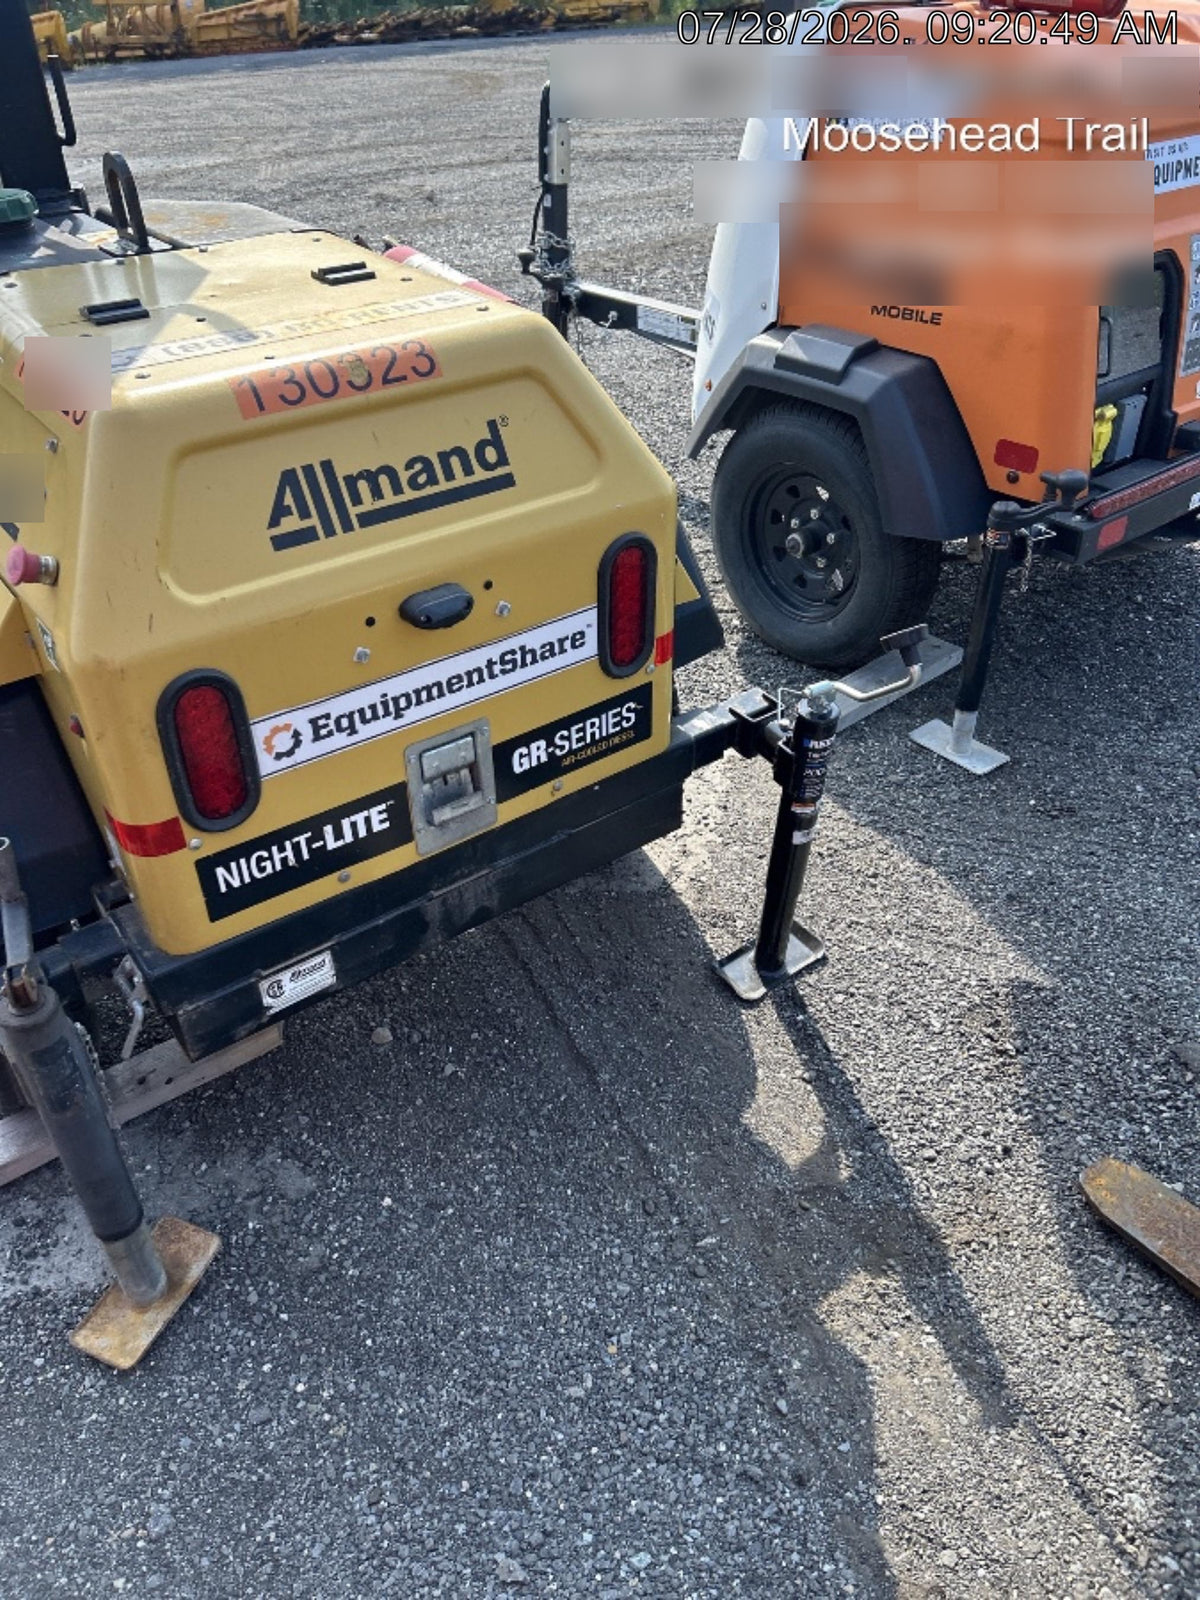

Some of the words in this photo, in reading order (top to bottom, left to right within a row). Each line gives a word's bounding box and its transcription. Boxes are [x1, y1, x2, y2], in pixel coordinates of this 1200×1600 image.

[870, 305, 943, 326] MOBILE
[236, 339, 438, 413] 130323
[267, 419, 510, 540] Allmand
[308, 627, 587, 743] EquipmentShare
[511, 701, 636, 774] GR-SERIES
[214, 802, 392, 893] NIGHT-LITE
